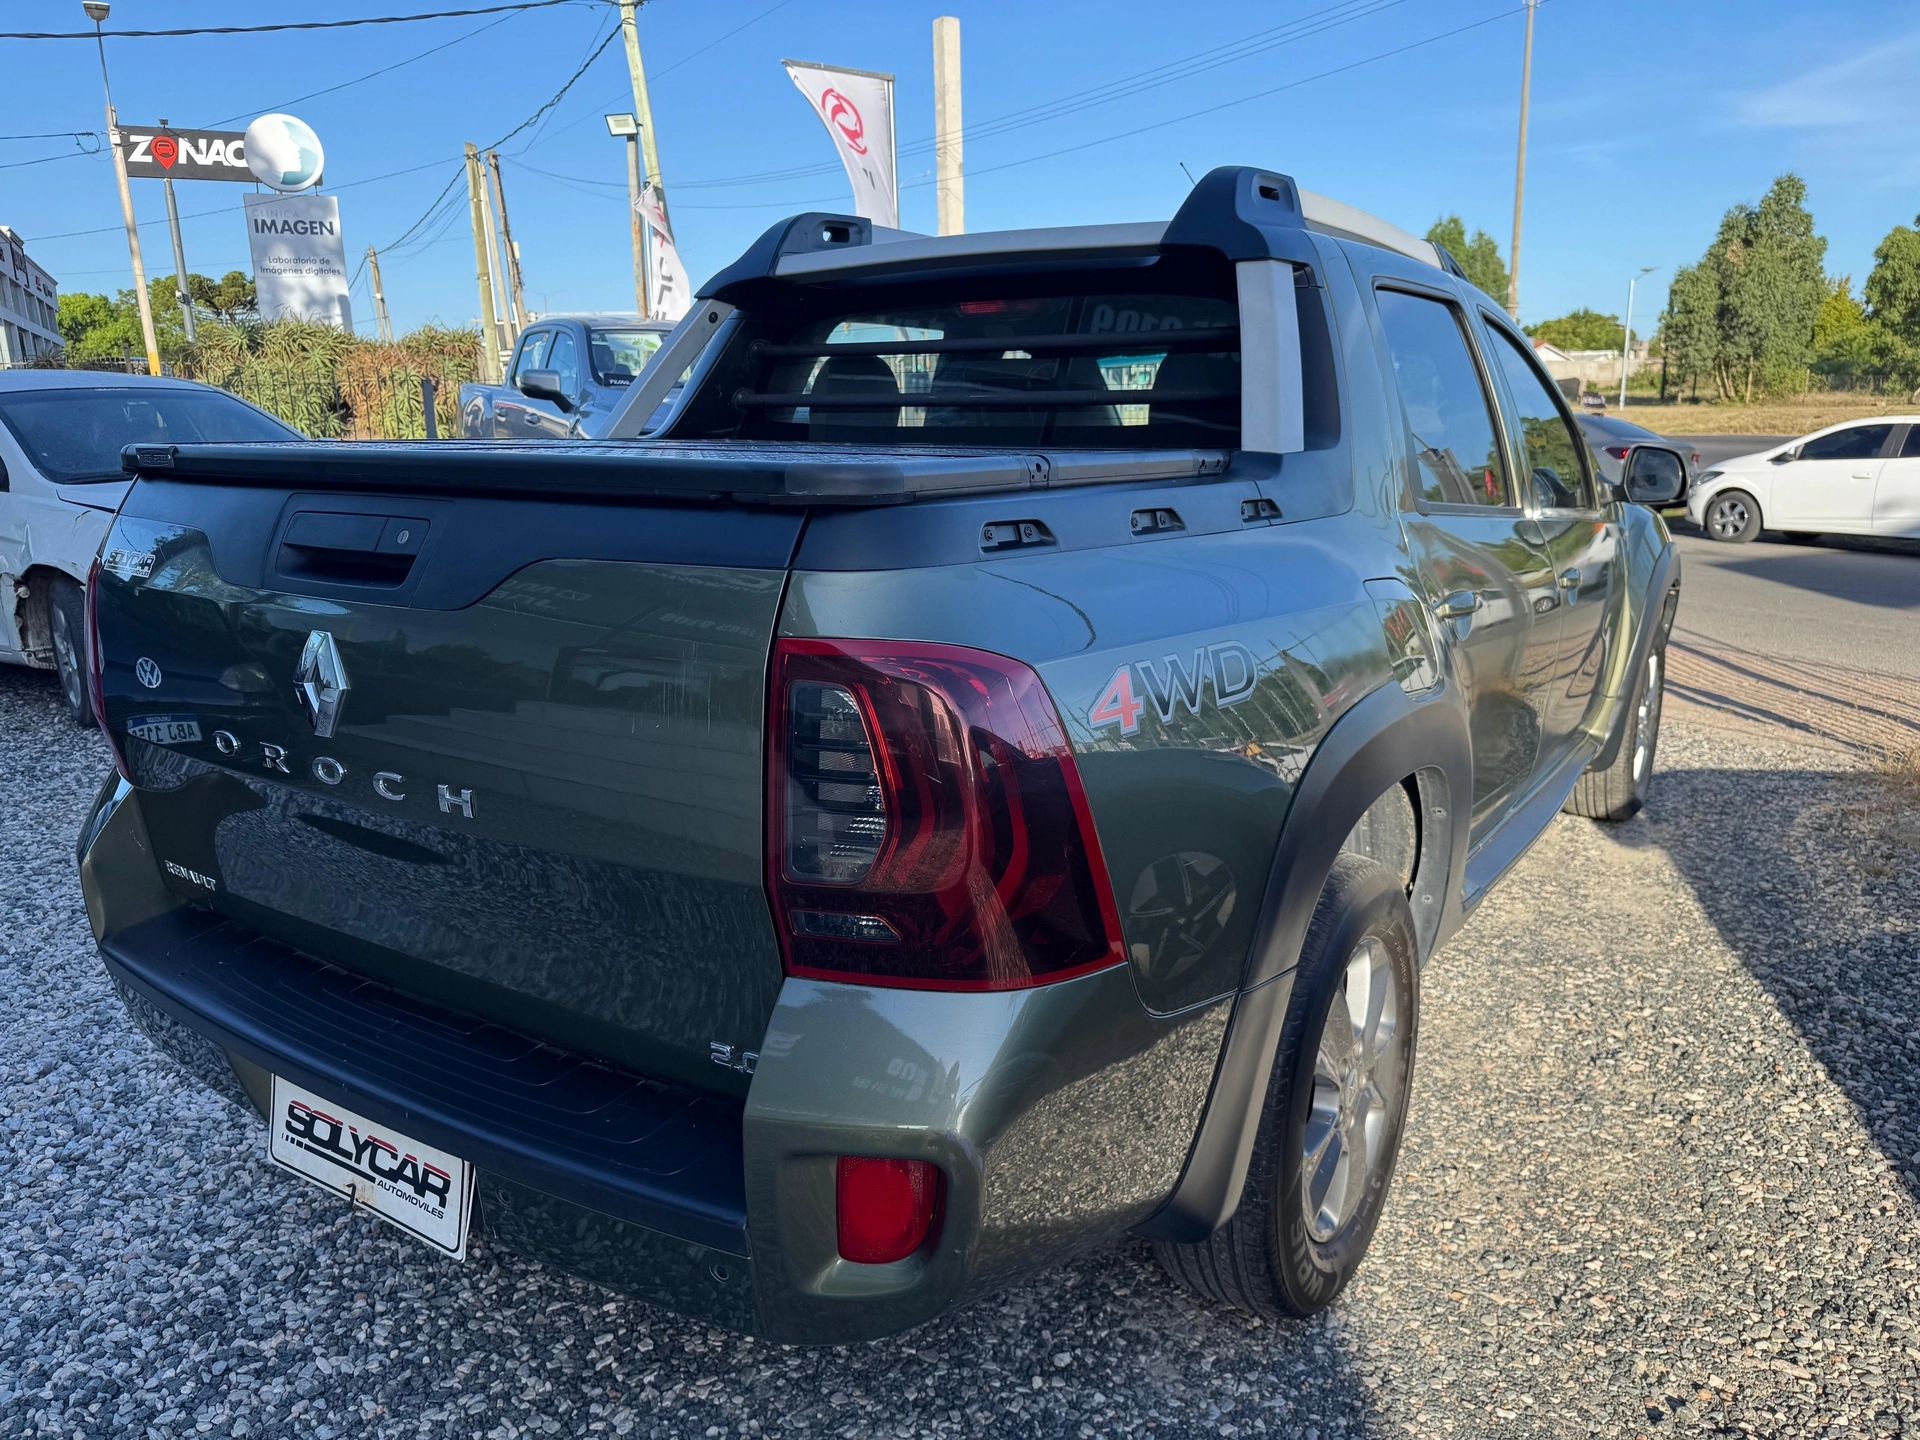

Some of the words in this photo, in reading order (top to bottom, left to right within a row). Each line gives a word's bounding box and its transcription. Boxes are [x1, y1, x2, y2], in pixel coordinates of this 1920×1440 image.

[254, 219, 334, 235] IMAGEN
[268, 256, 317, 264] Laboratorio
[319, 257, 330, 265] de
[305, 267, 341, 276] digitales
[1088, 640, 1257, 738] 4WD
[213, 729, 477, 819] OROCH
[165, 860, 216, 891] RENAULT
[285, 1100, 451, 1209] SOLYCAR
[377, 1179, 445, 1220] AUTOMOVILES
